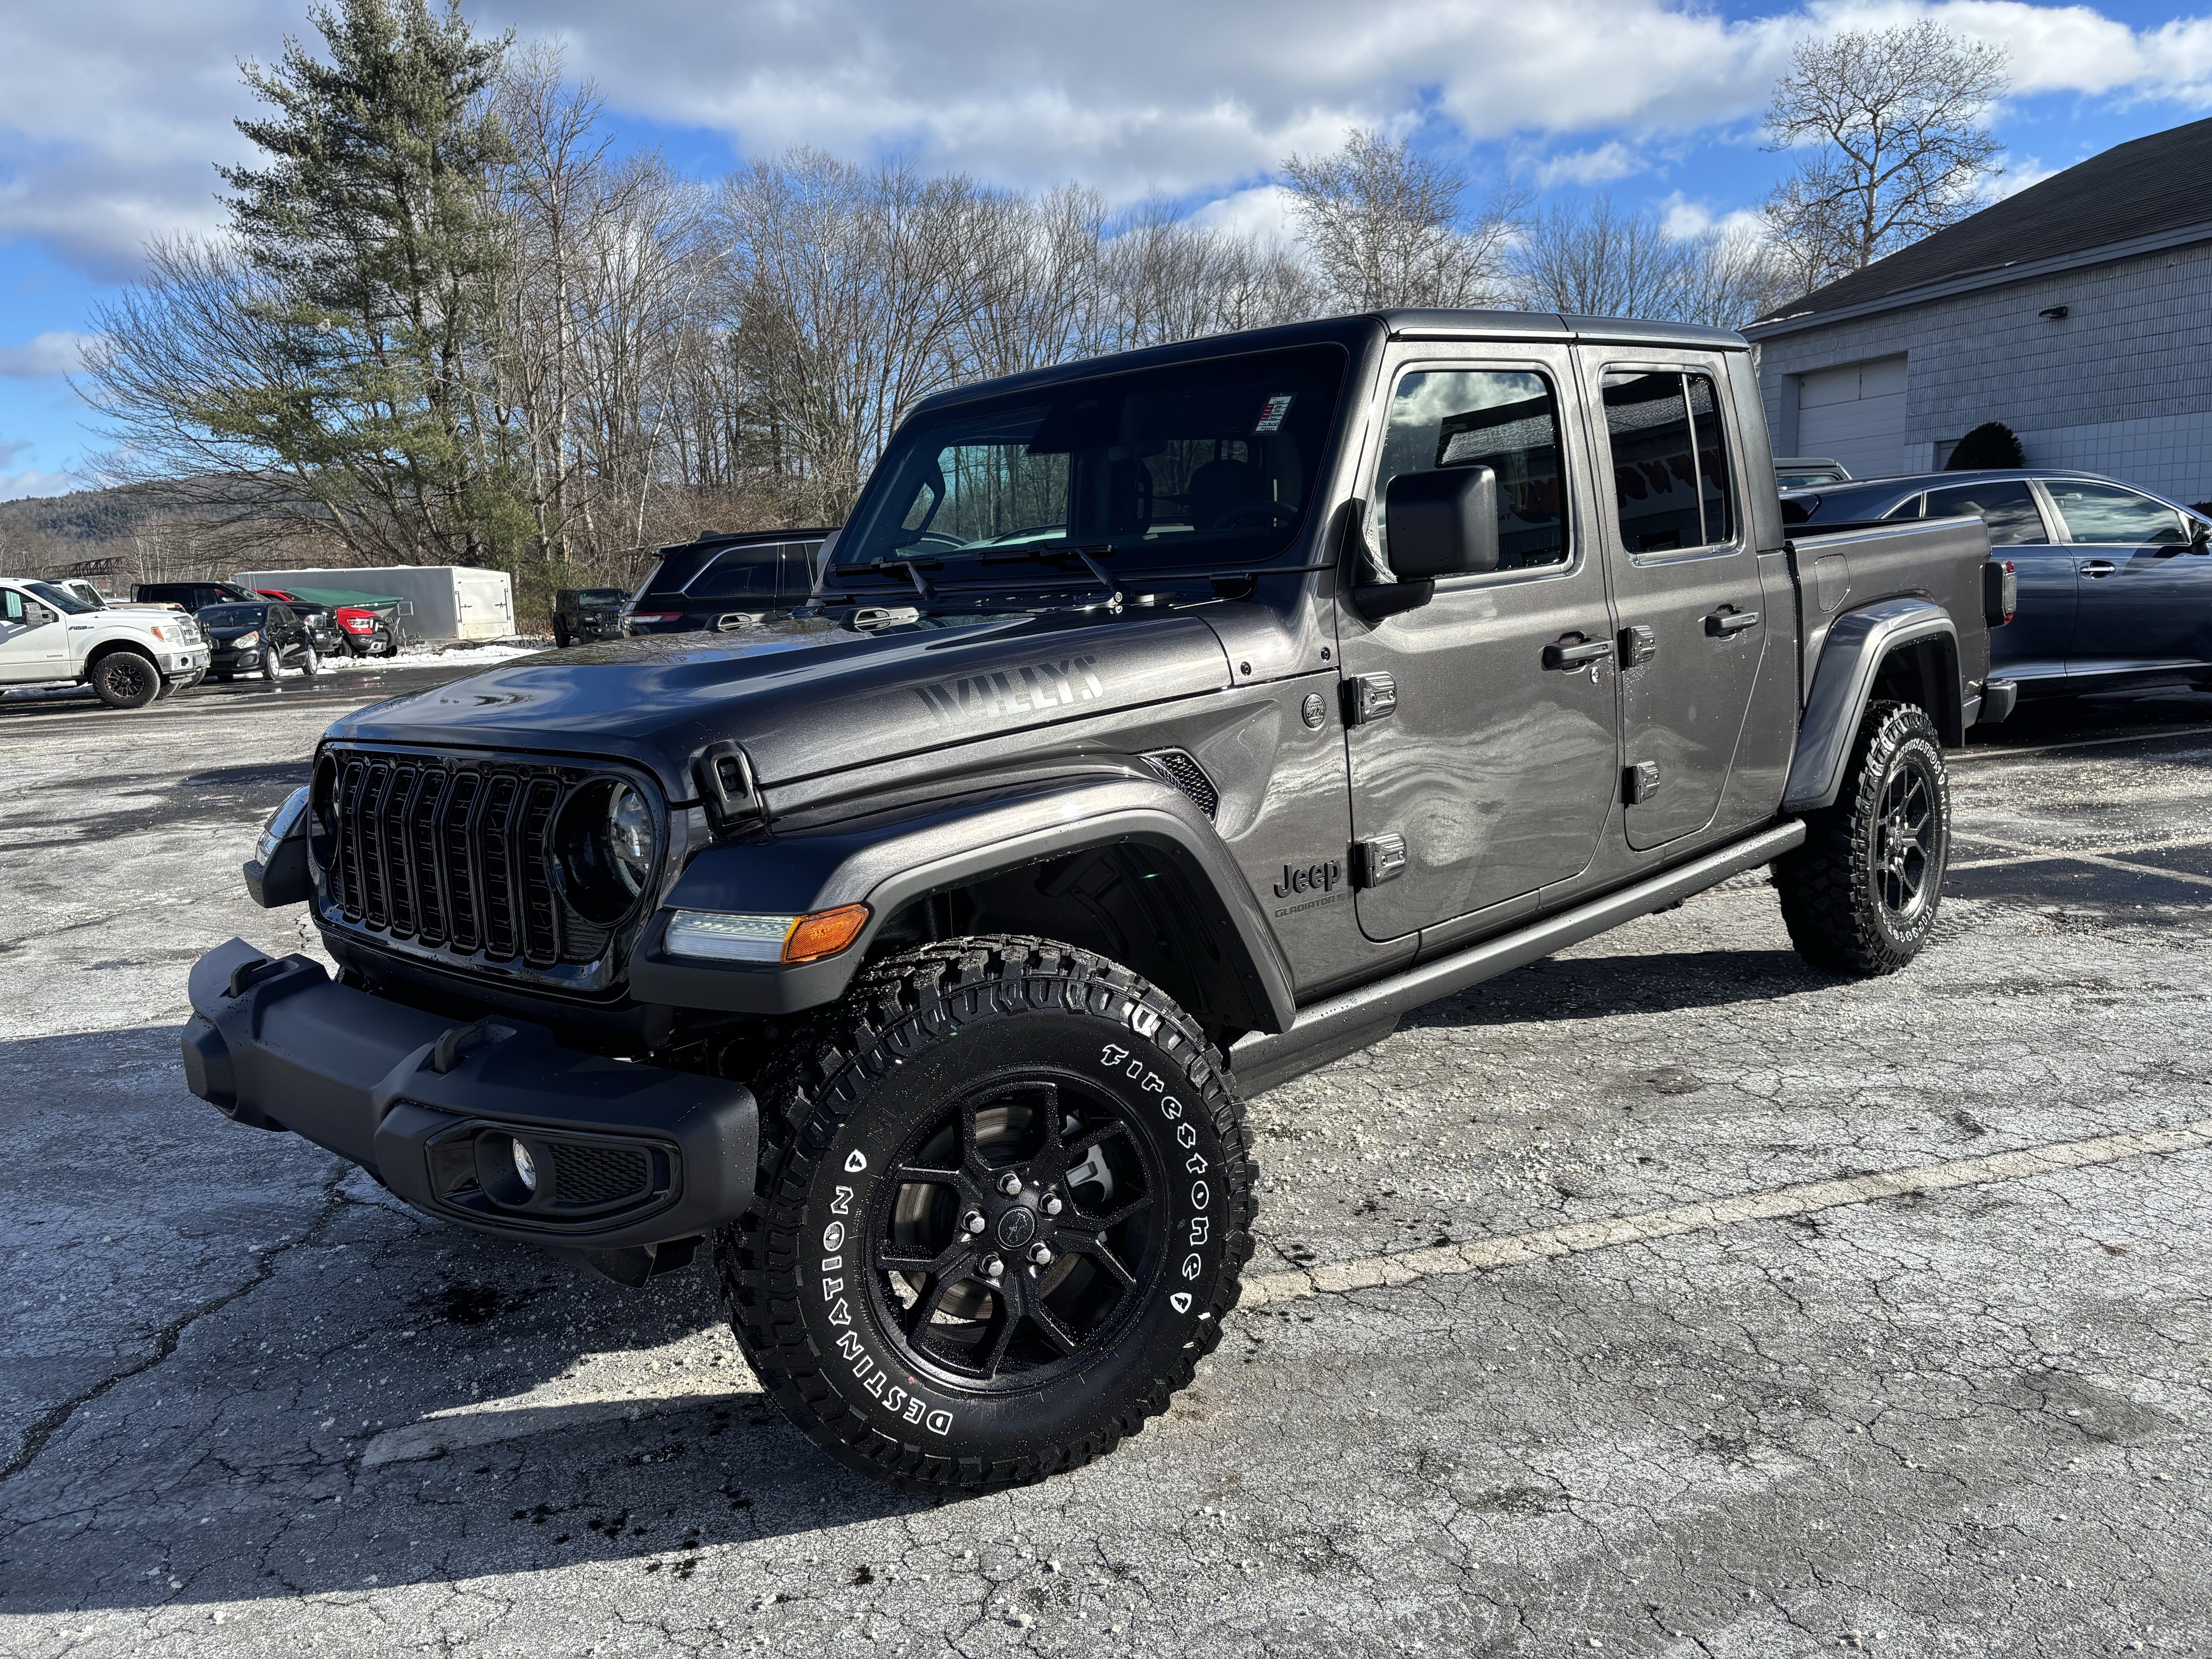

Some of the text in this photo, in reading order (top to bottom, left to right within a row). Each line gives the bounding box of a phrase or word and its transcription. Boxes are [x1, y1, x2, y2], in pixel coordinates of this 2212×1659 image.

[913, 656, 1104, 728] WILLYS
[1890, 738, 1942, 774] DESTINATION
[1274, 859, 1341, 898] Jeep
[1274, 896, 1335, 918] GLADIATOR
[1101, 1043, 1210, 1280] Firestone
[822, 1185, 953, 1436] DESTINATION
